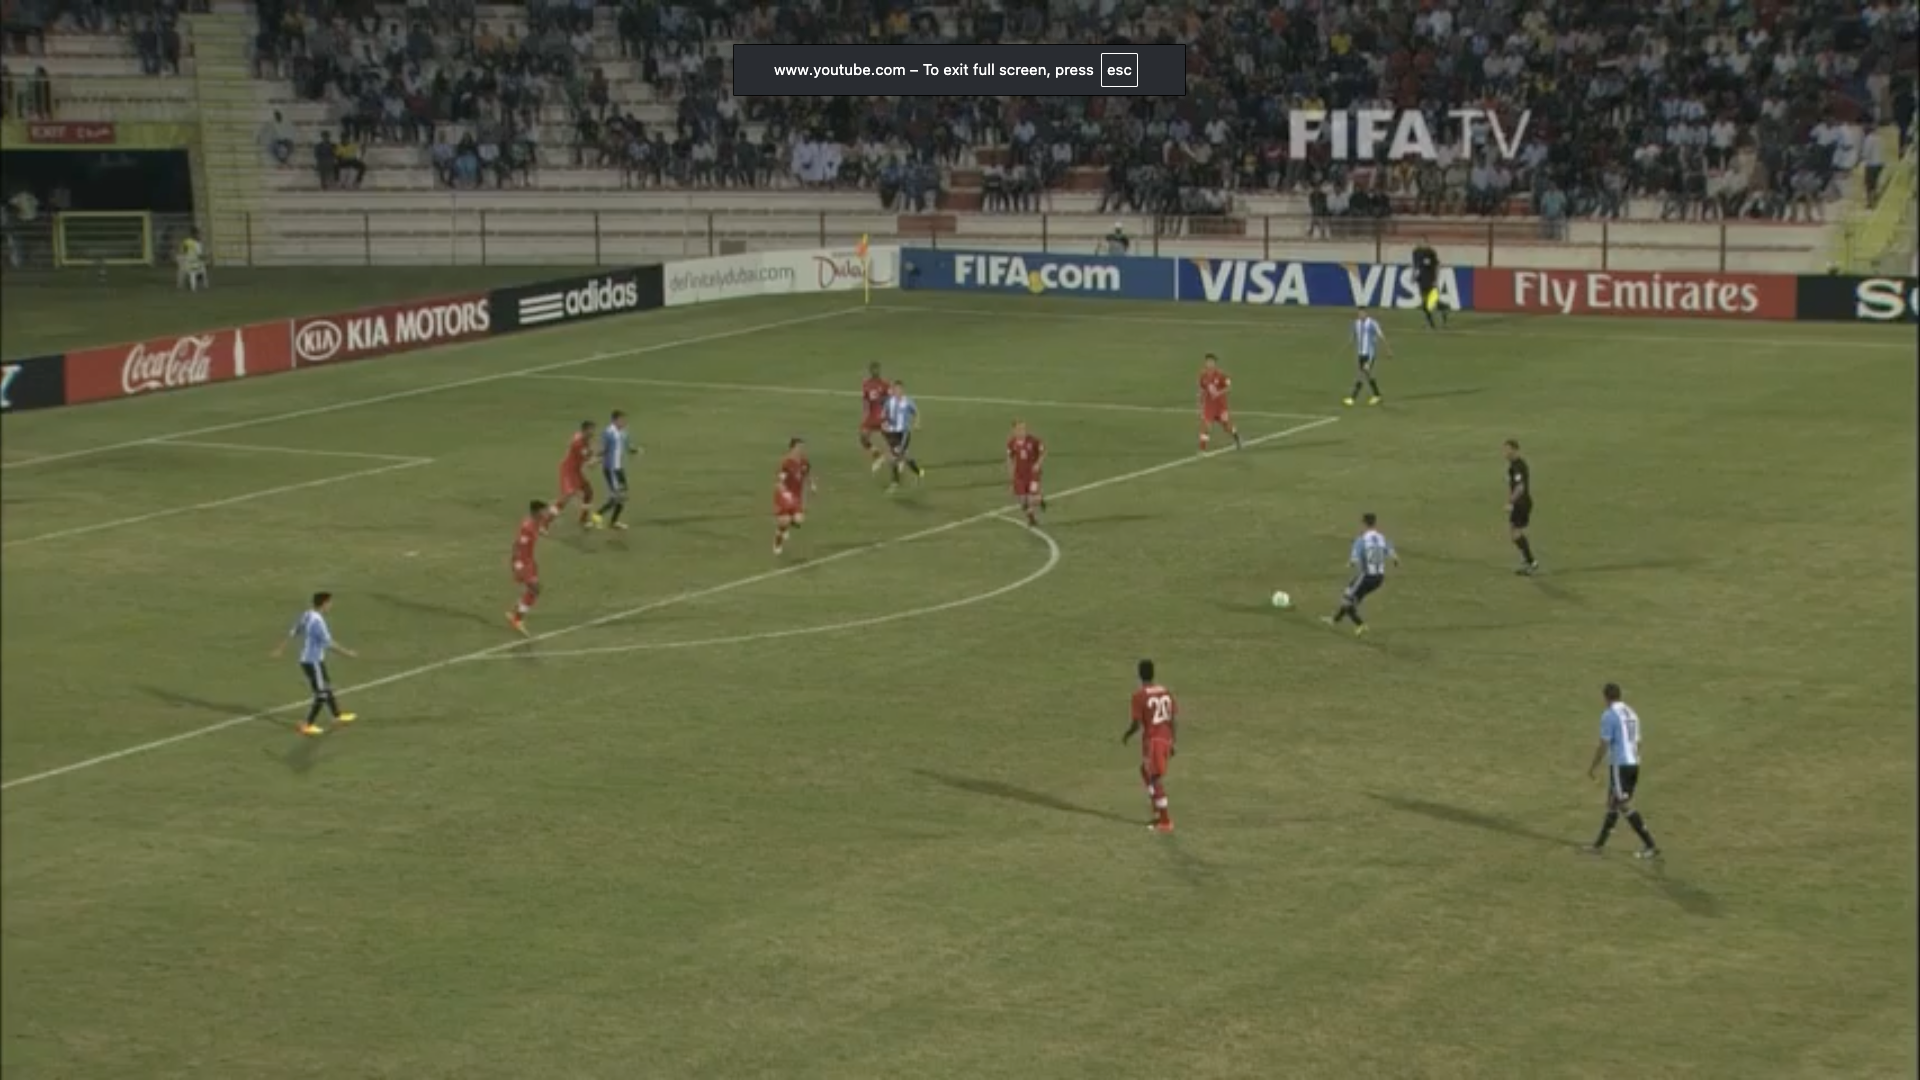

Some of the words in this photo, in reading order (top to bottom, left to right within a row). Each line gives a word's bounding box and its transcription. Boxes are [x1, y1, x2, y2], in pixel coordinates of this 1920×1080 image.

[954, 254, 1121, 291] FIFAcom
[1197, 260, 1309, 305] VISA
[1514, 271, 1577, 314] Fly
[1587, 273, 1759, 312] Emirates
[565, 277, 637, 316] adidas
[1856, 278, 1918, 320] S
[303, 330, 334, 352] KIA
[347, 315, 389, 351] KIA
[395, 298, 491, 343] MOTORS
[1148, 695, 1172, 725] 20
